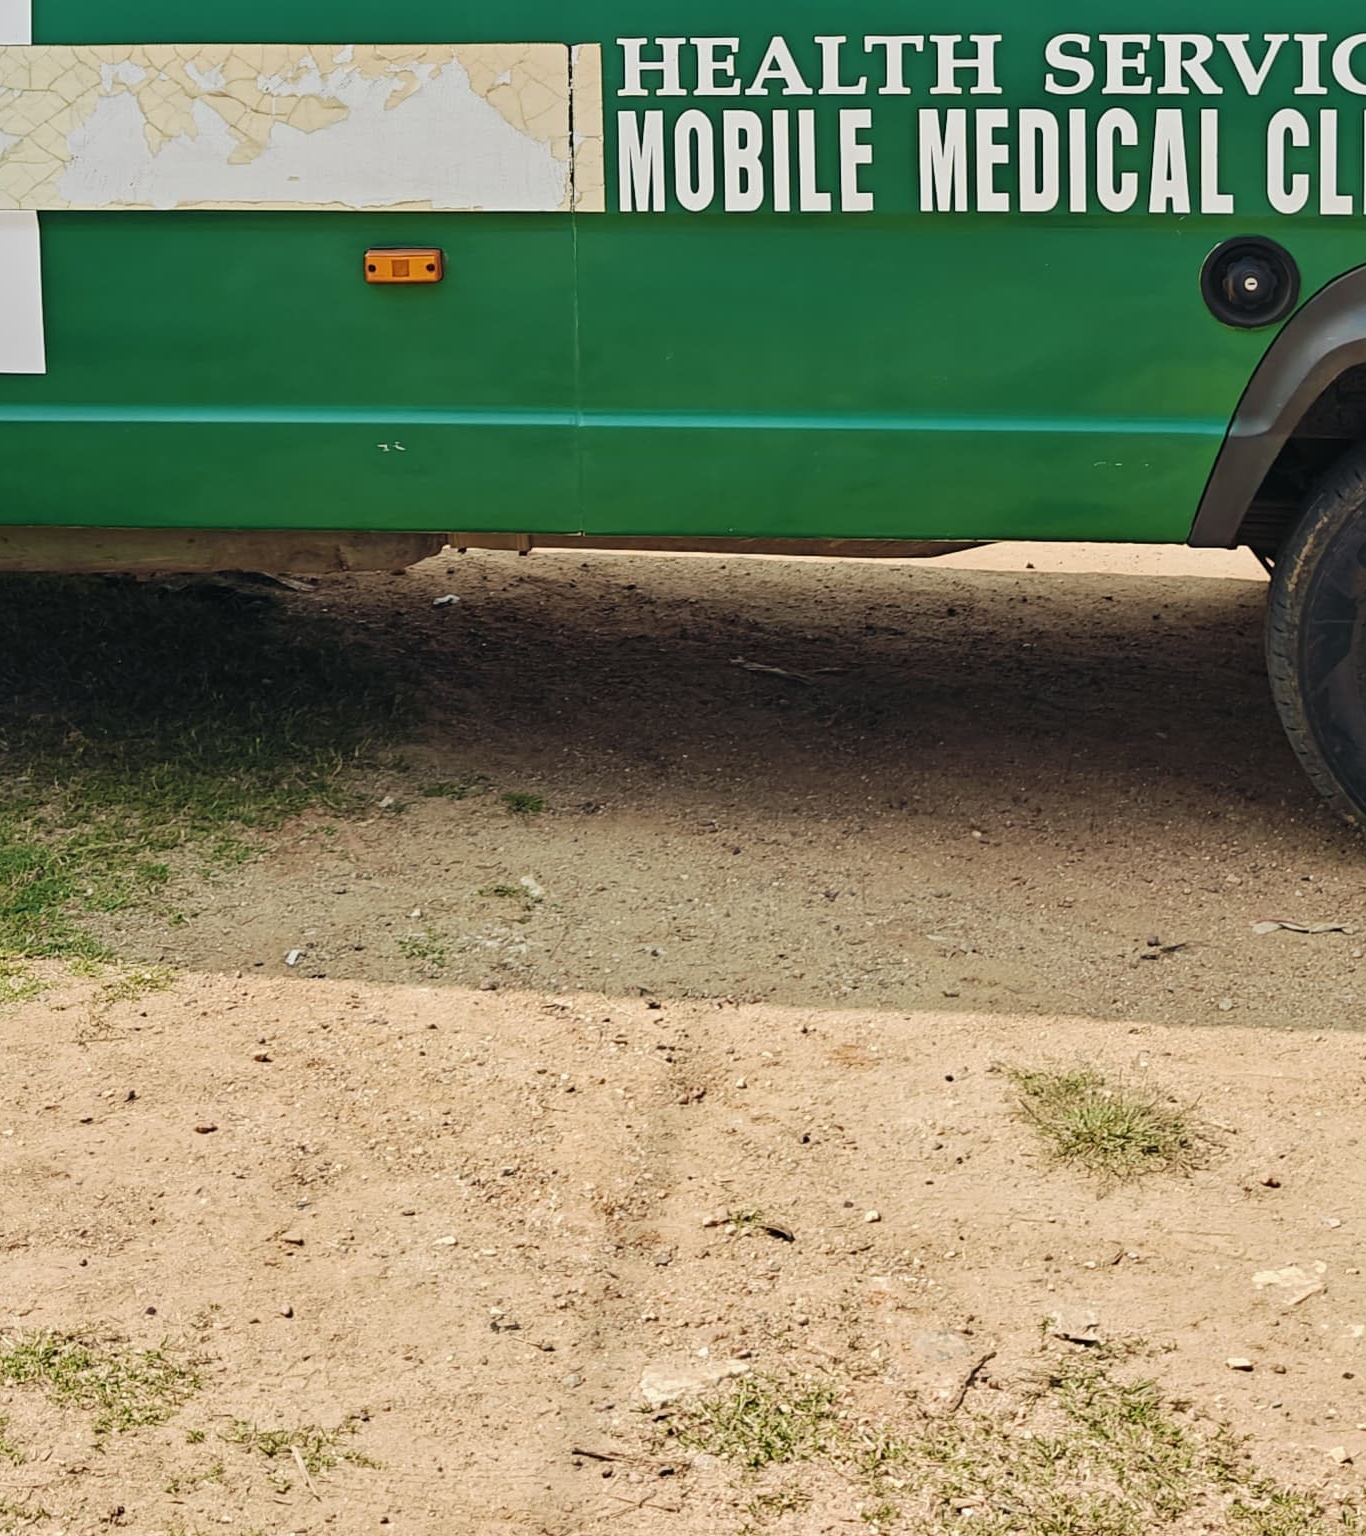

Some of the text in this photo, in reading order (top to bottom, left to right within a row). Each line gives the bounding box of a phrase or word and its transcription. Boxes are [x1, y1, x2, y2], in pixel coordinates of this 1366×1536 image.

[617, 34, 1003, 97] HEALTH
[617, 108, 874, 213] MOBILE
[919, 108, 1235, 215] MEDICAL
